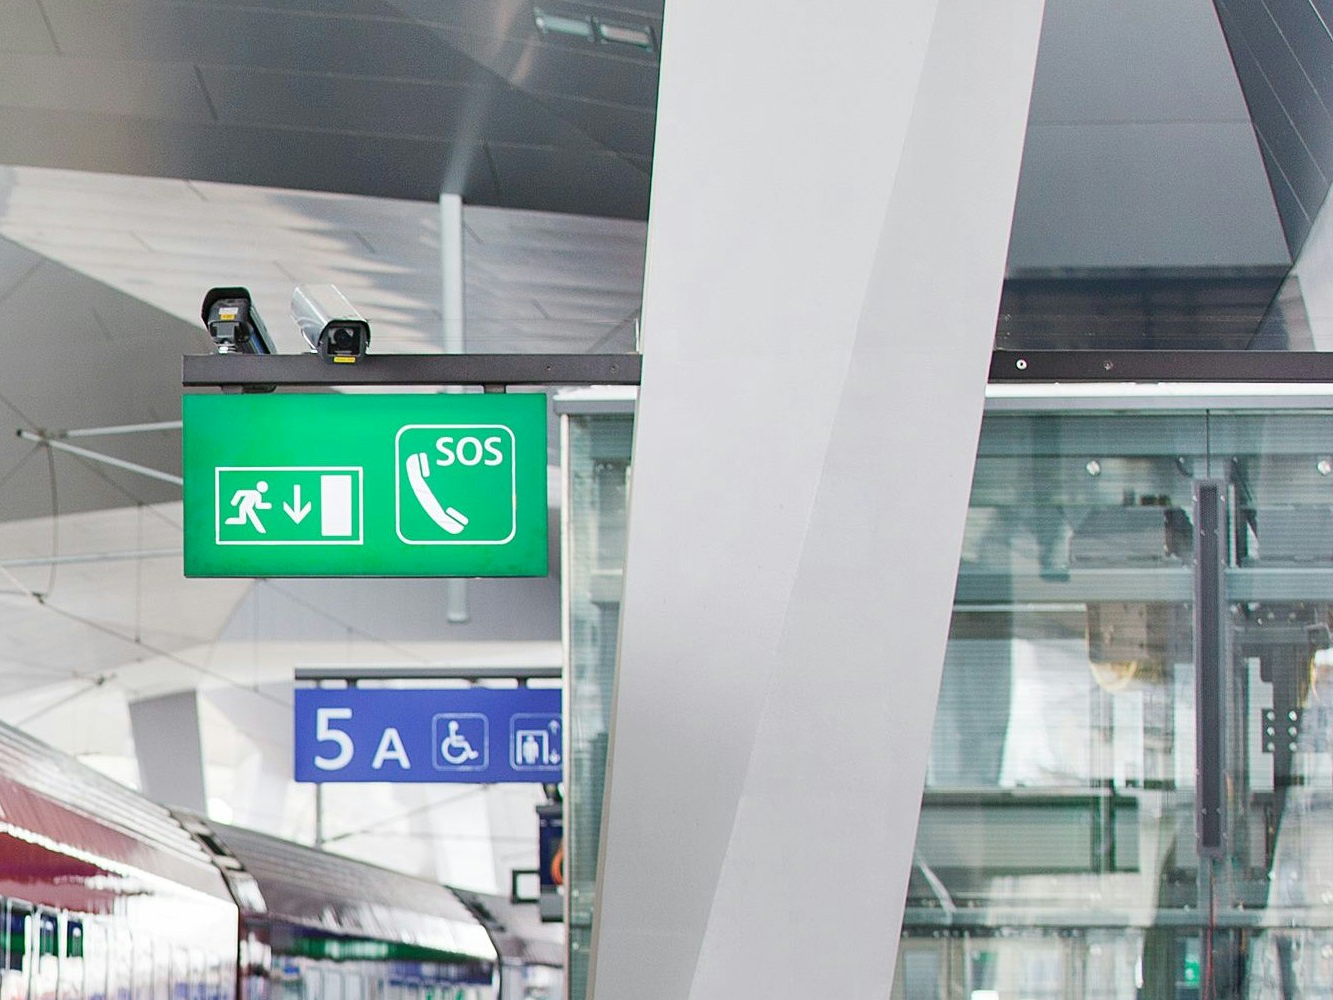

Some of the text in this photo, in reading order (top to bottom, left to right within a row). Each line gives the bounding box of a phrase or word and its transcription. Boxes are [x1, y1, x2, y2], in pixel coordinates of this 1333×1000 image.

[435, 435, 504, 467] SOS
[314, 707, 411, 770] 5 A
